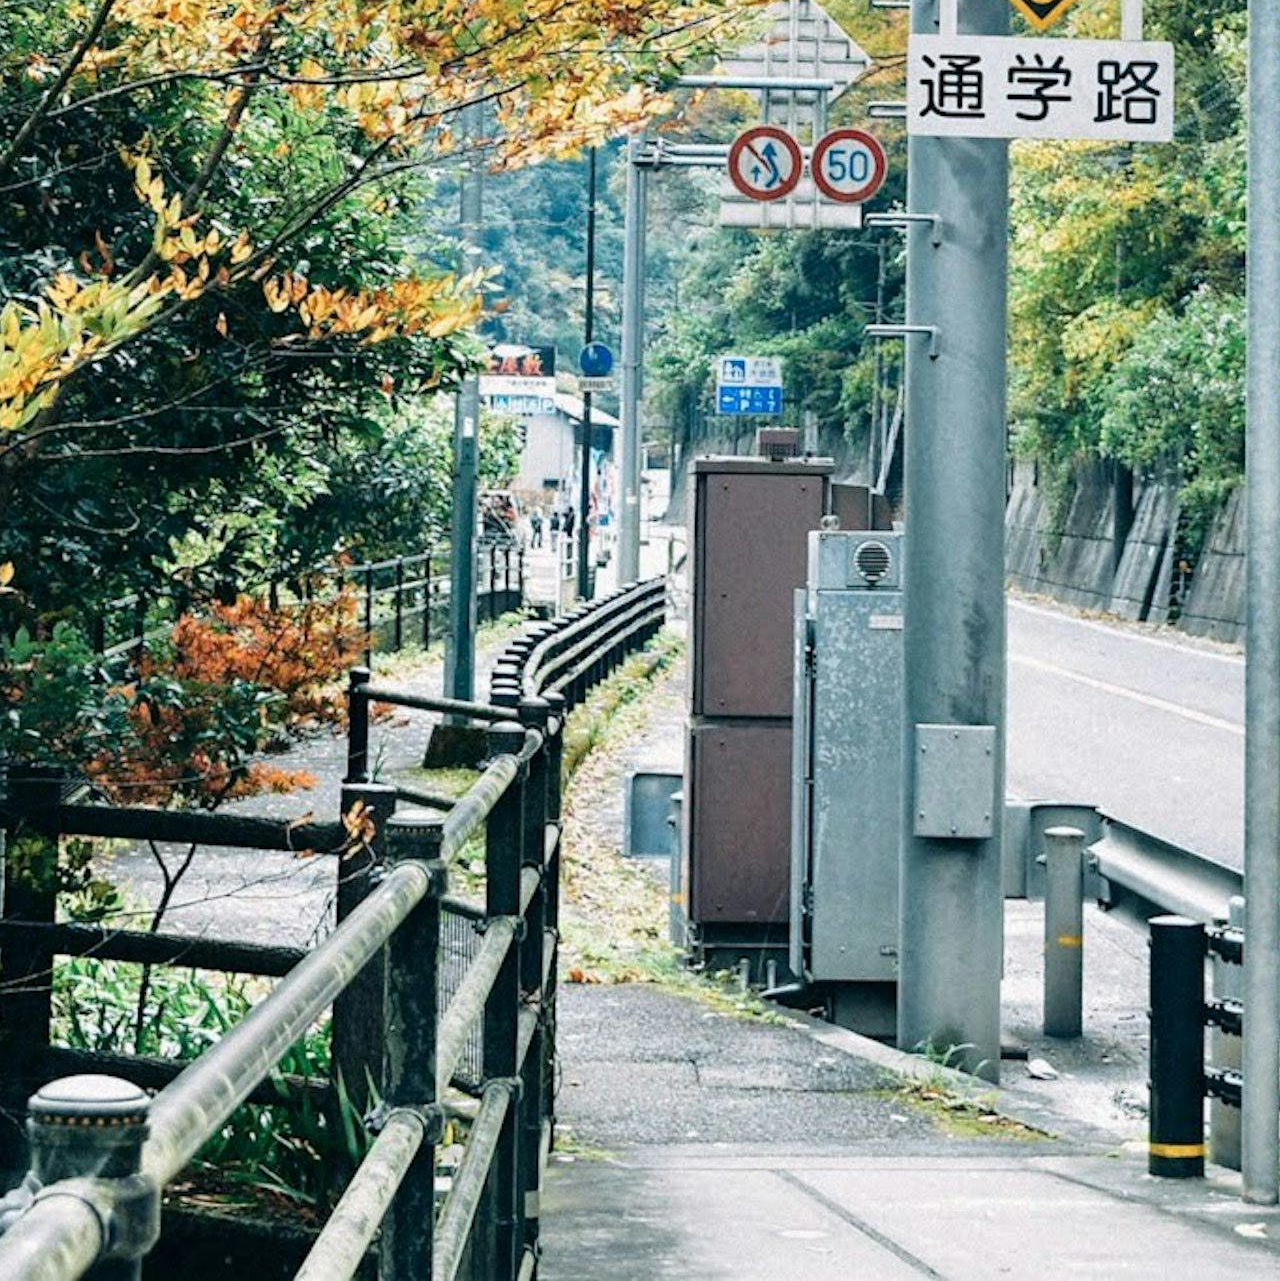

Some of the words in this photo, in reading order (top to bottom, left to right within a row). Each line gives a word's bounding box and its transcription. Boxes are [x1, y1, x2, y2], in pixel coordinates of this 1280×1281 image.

[919, 54, 1161, 124] 通学路
[829, 150, 868, 182] 50
